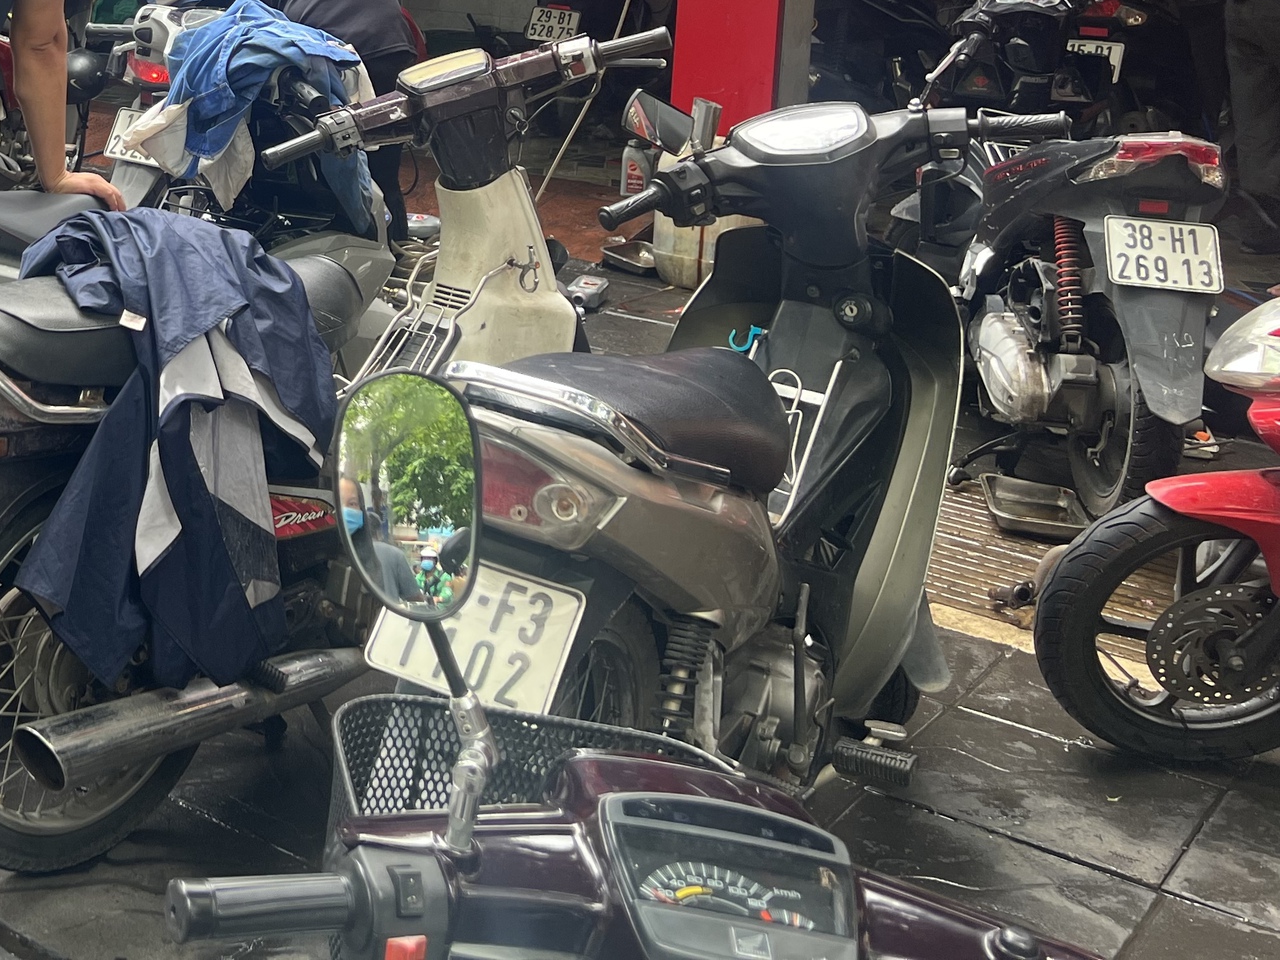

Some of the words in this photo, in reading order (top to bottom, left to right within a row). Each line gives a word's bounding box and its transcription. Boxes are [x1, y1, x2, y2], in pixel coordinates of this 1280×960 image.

[536, 9, 573, 26] 29-B1
[529, 23, 575, 39] 528.75
[1122, 222, 1200, 255] 38-H1
[1116, 252, 1214, 288] 269.13
[668, 878, 686, 888] 40
[686, 874, 704, 885] 60
[706, 878, 725, 889] 80
[728, 885, 749, 897] 100
